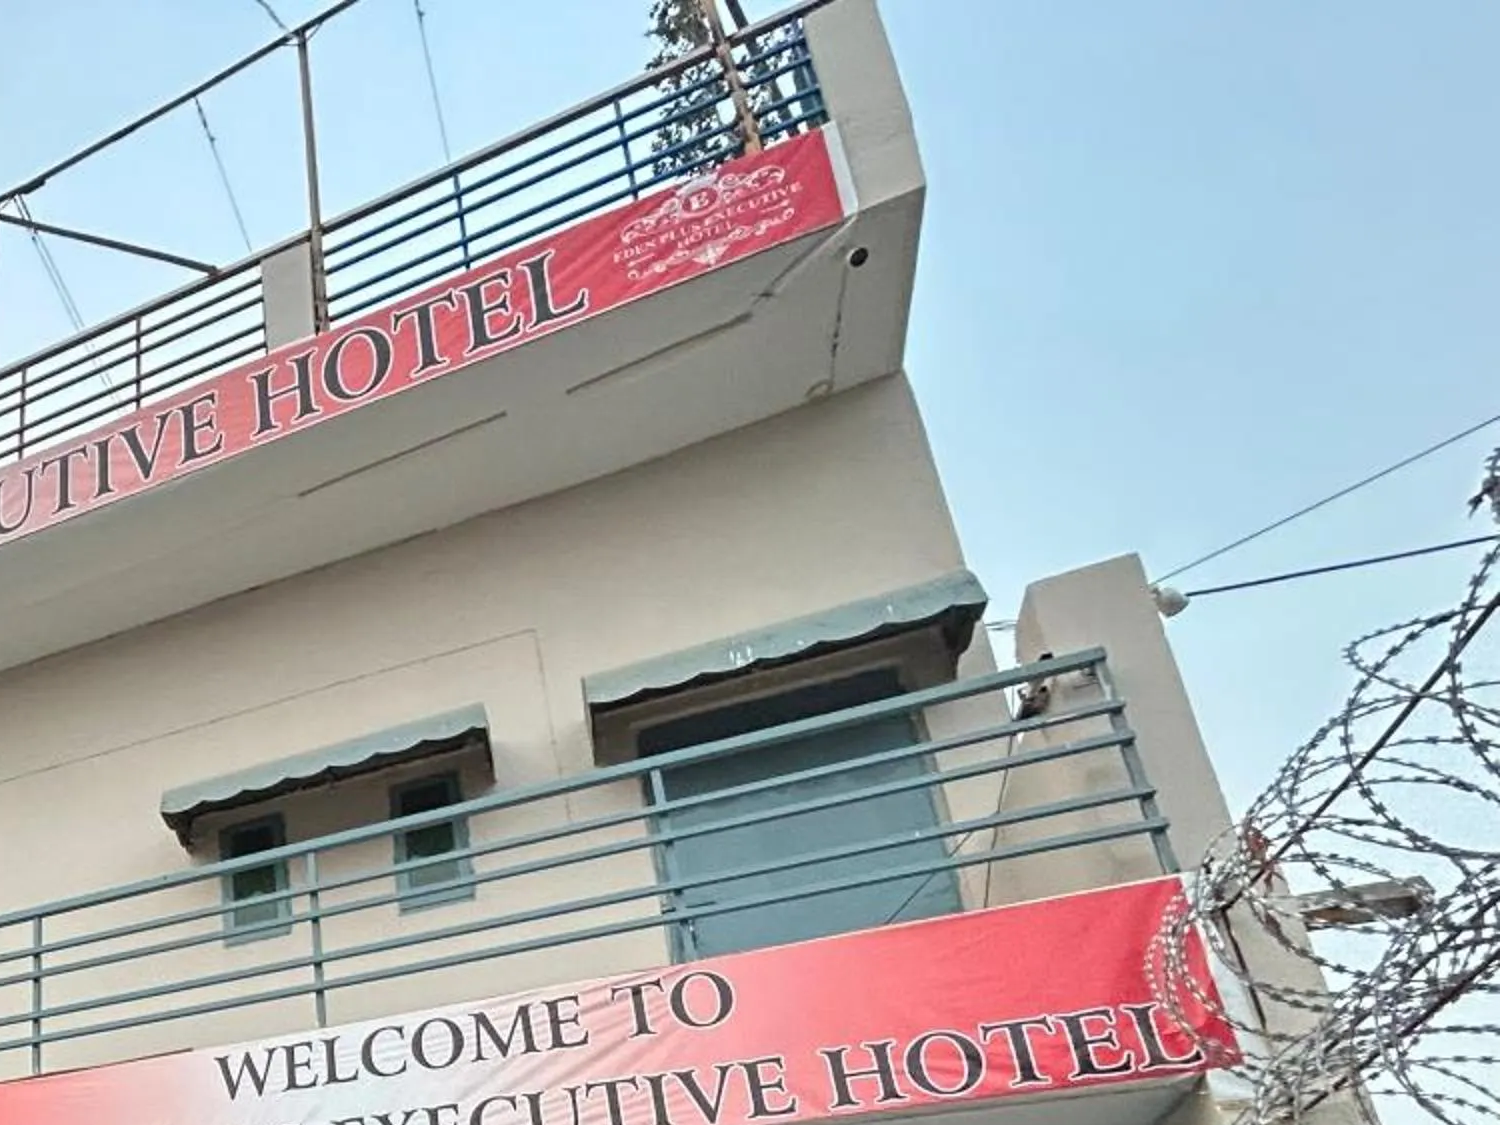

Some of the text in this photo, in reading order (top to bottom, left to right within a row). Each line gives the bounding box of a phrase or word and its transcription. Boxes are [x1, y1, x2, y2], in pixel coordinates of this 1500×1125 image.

[613, 239, 657, 264] EDEN
[704, 181, 804, 226] EXECUTIVE
[677, 220, 734, 250] HOTEL
[250, 247, 589, 437] HOTEL
[214, 970, 735, 1101] WELCOME TO
[820, 1001, 1203, 1110] HOTEL
